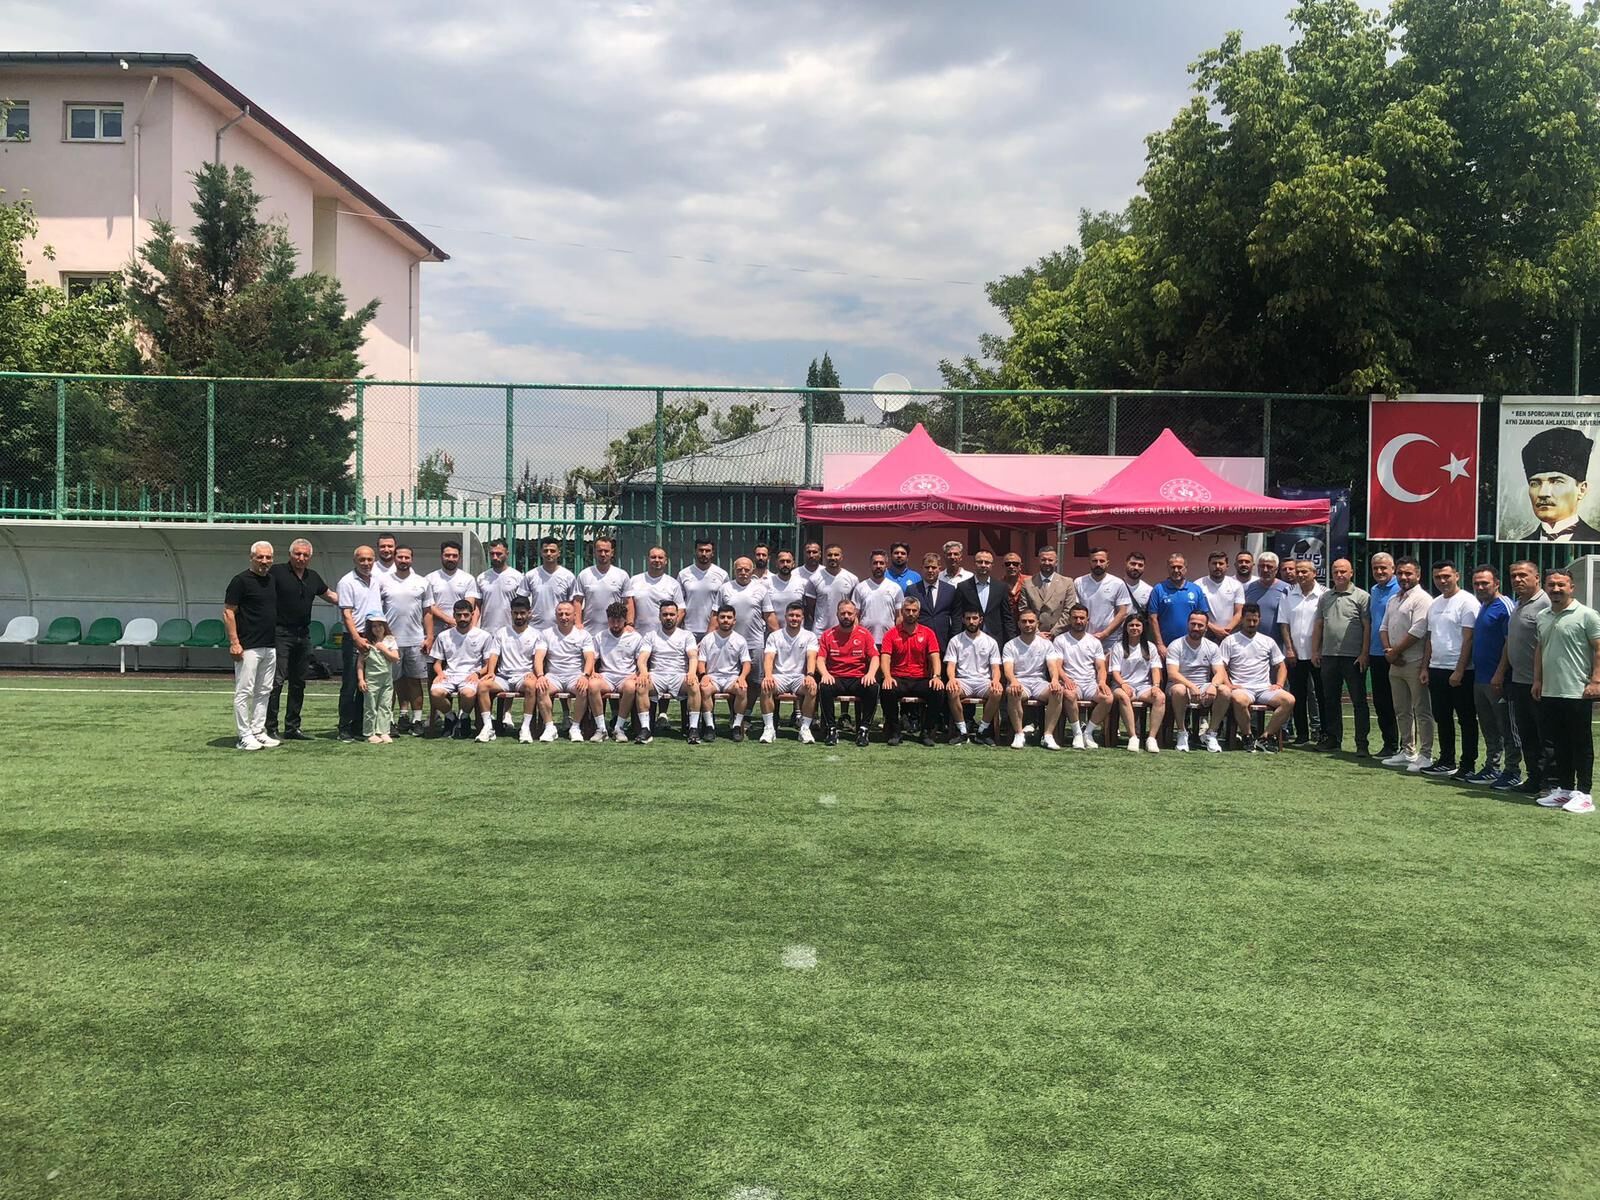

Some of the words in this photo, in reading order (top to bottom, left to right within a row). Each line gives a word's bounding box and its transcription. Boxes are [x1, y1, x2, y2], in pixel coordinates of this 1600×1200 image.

[868, 502, 905, 512] GENÇLİK
[921, 502, 944, 510] SPOR
[947, 501, 954, 510] İL
[1138, 505, 1175, 515] GENÇLİK
[1179, 506, 1190, 514] VE
[1192, 506, 1216, 514] SPOR
